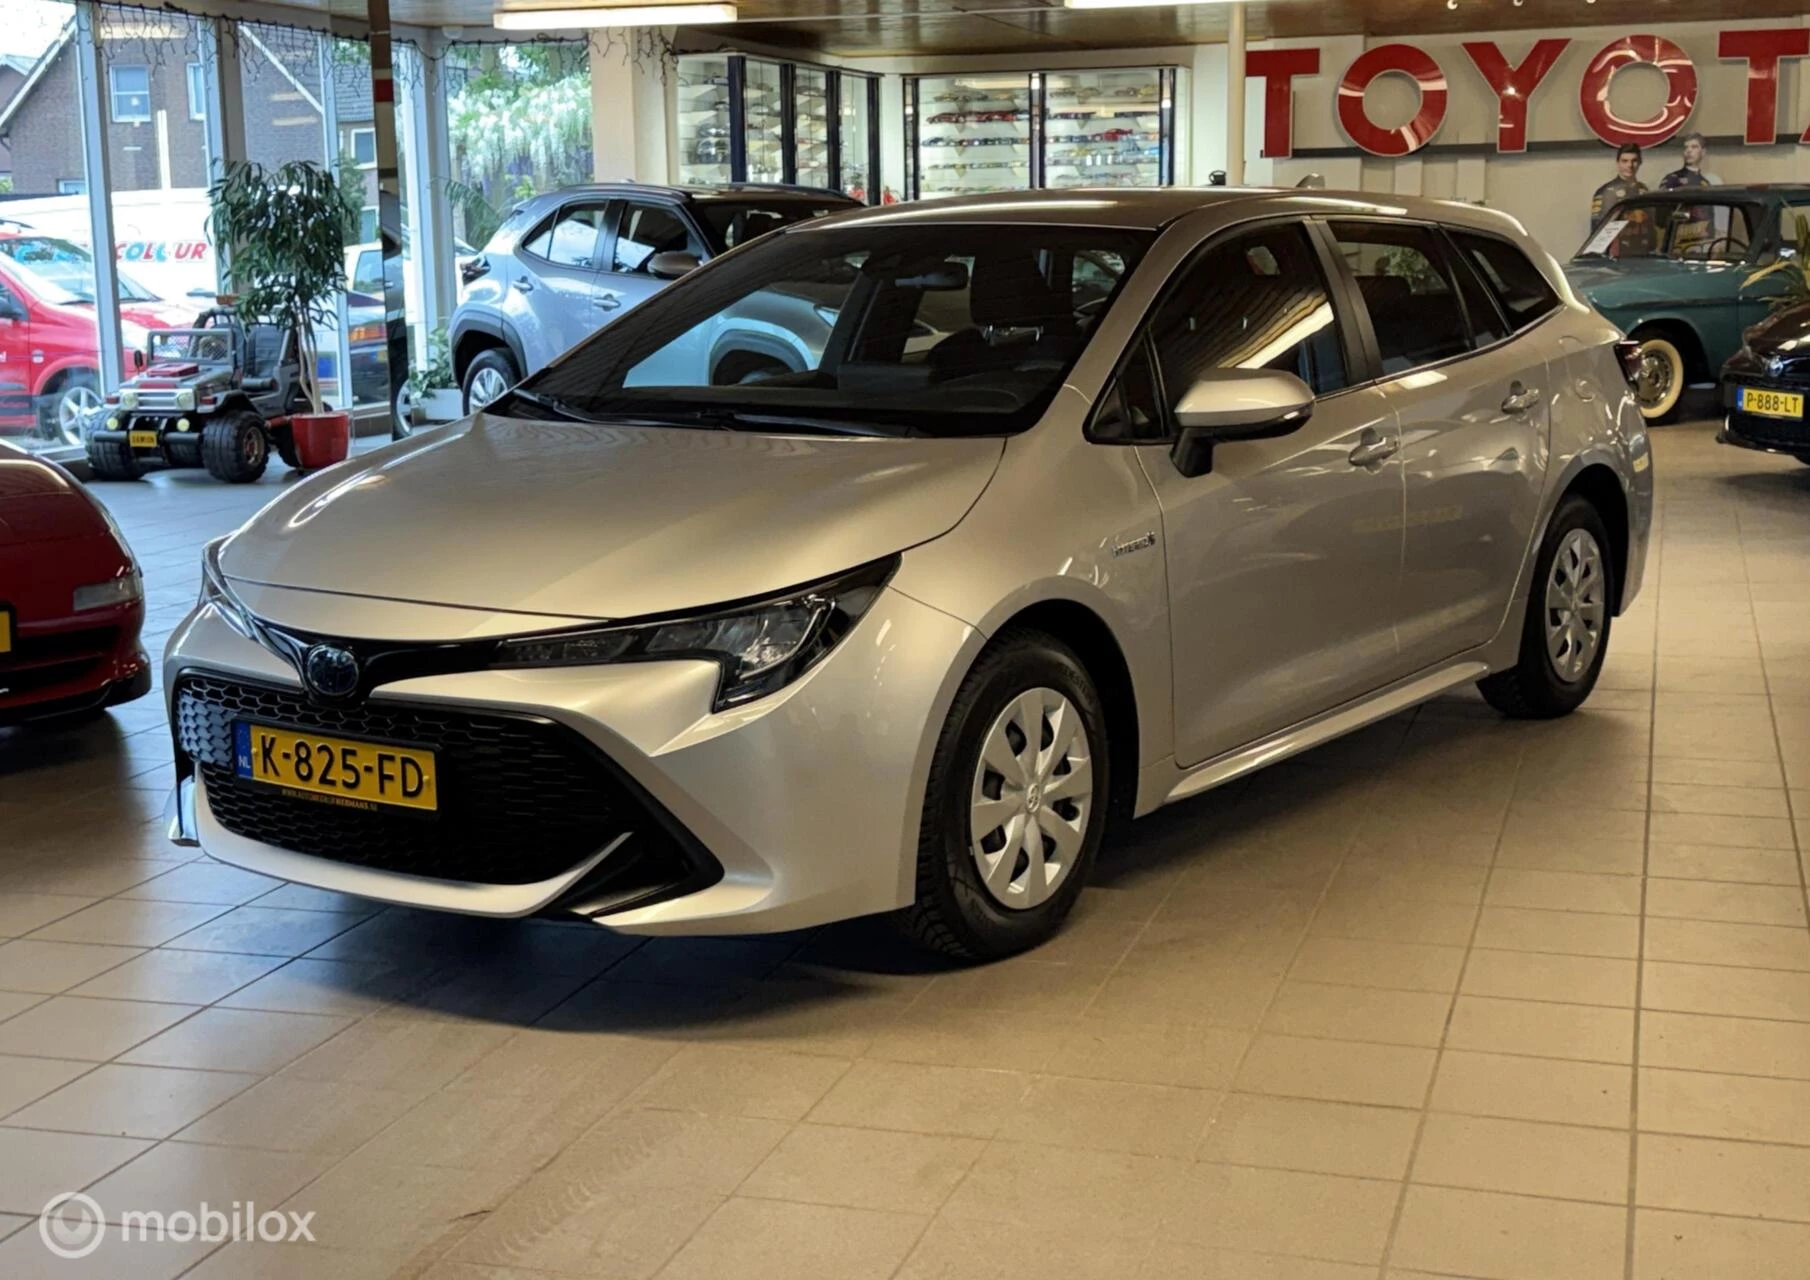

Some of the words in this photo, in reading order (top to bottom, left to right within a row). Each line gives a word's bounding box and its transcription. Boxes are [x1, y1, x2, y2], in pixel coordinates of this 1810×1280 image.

[1246, 29, 1810, 158] TOYOT
[1746, 392, 1799, 413] P-888-LT
[238, 755, 251, 769] NL
[260, 734, 425, 799] K-825-FD
